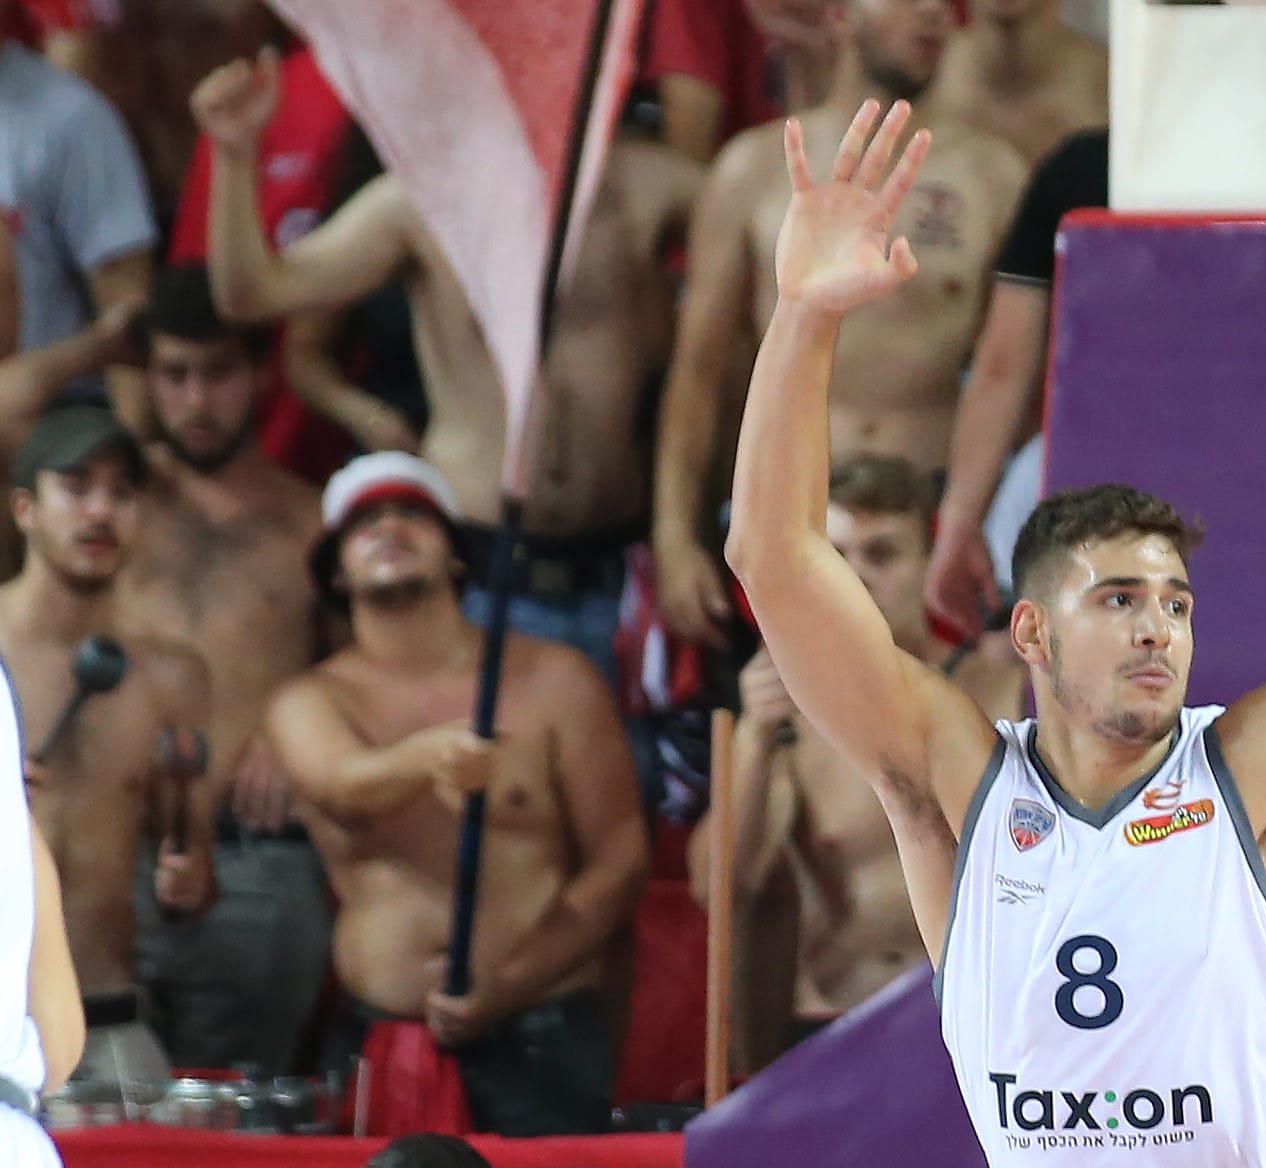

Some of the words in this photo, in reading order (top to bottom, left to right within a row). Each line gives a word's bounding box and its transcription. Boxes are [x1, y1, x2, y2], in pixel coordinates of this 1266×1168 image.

[995, 873, 1045, 894] Reebok
[1054, 934, 1125, 1030] 8
[988, 1072, 1214, 1131] Tax:on
[1005, 1135, 1032, 1150] שלך
[1036, 1133, 1079, 1151] הכסף
[1083, 1135, 1105, 1148] את
[1109, 1132, 1147, 1150] לקבל
[1153, 1130, 1195, 1146] פשוט
